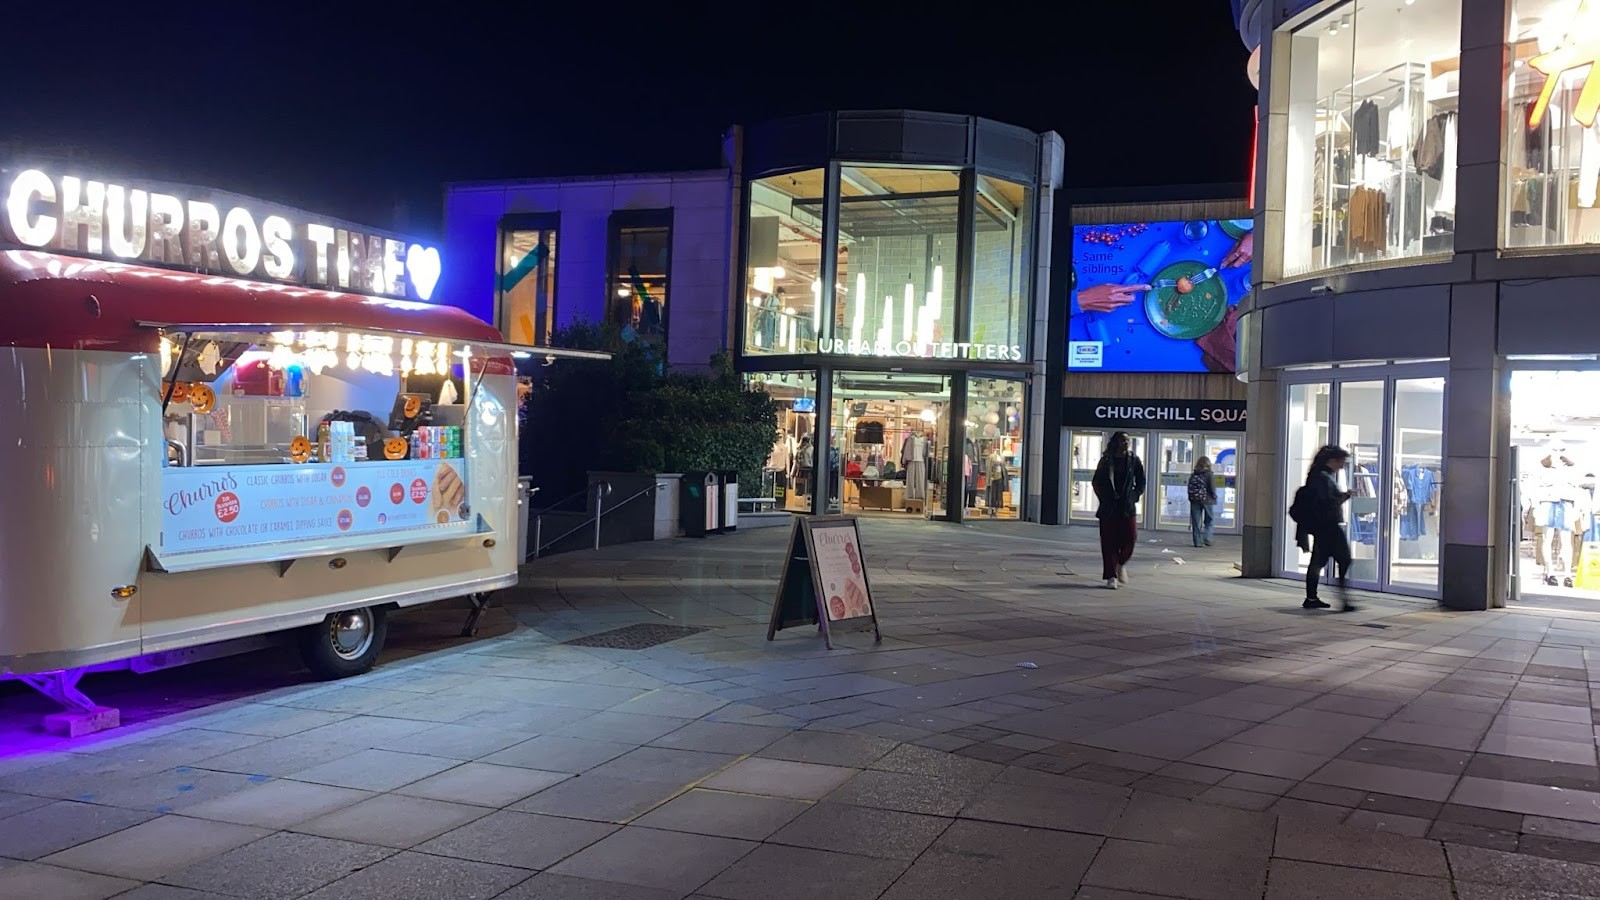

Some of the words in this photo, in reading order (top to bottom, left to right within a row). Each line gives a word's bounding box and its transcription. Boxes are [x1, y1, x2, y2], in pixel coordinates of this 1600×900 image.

[7, 169, 294, 279] CHURROS
[307, 223, 406, 297] TIME
[1082, 252, 1114, 262] Same
[1082, 263, 1127, 276] siblings.
[818, 338, 890, 356] URBAN
[895, 340, 1022, 361] OUTFITTERS
[1095, 406, 1196, 421] CHURCHILL
[246, 475, 269, 486] CLASSIC
[271, 474, 295, 485] CHURROS
[296, 473, 310, 483] WITH
[311, 472, 327, 483] SUGAR
[163, 472, 237, 515] Churros
[217, 505, 239, 519] £2.50
[178, 528, 206, 541] CHURROS
[208, 526, 224, 538] WITH
[225, 523, 259, 536] CHOCOLATE
[260, 522, 268, 532] OR
[269, 520, 294, 532] CARAMEL
[295, 518, 316, 530] DIPPING
[317, 517, 332, 528] SAUCE
